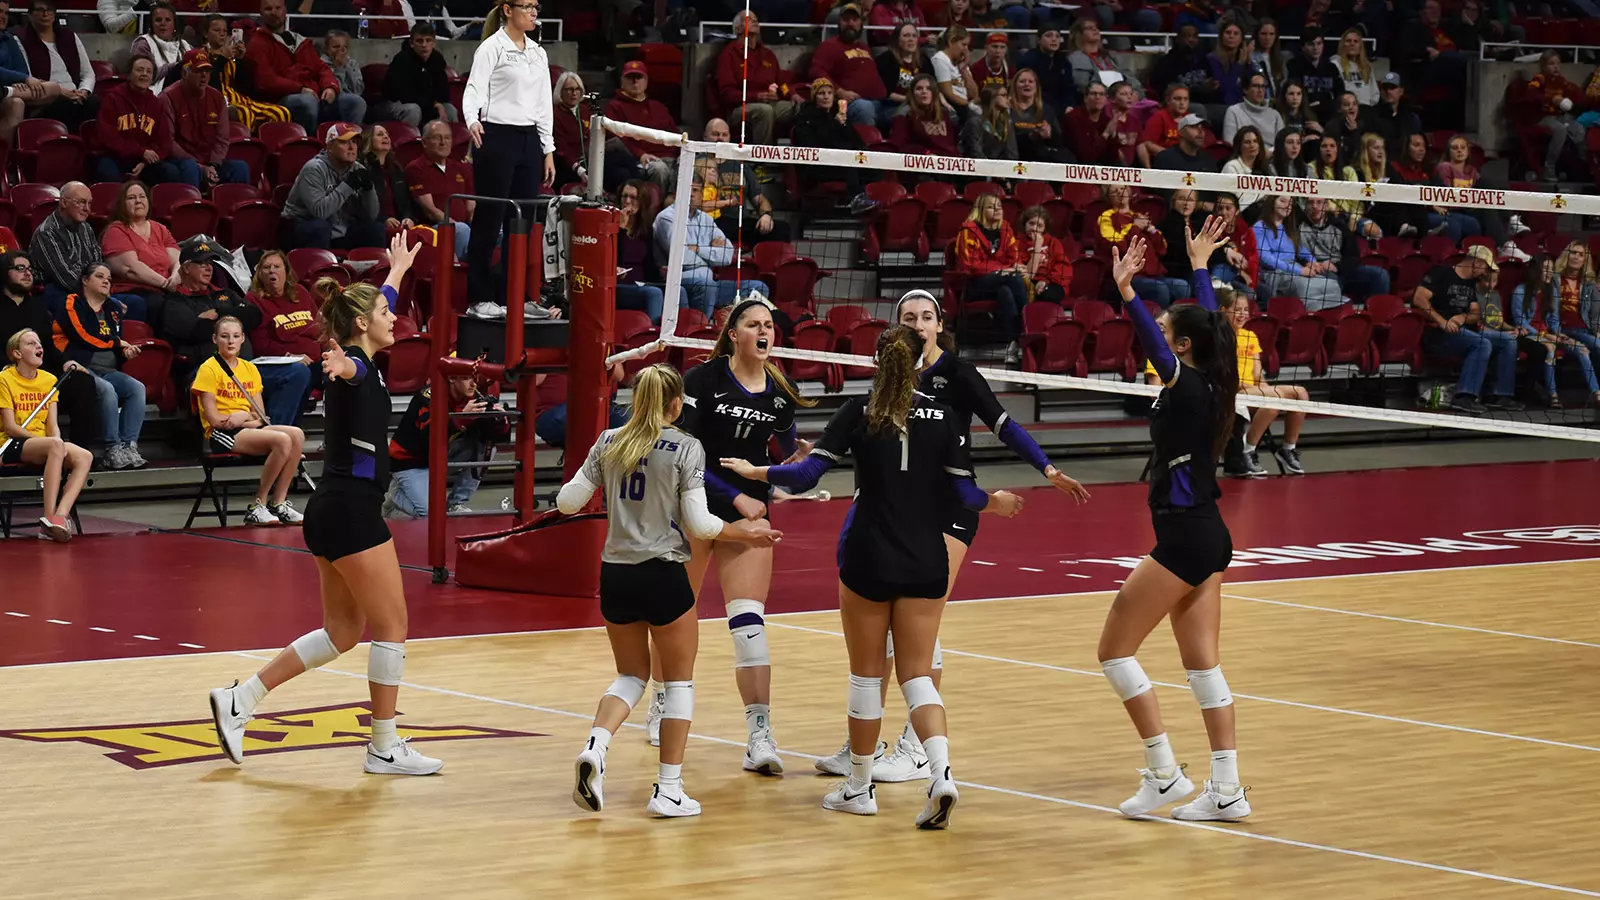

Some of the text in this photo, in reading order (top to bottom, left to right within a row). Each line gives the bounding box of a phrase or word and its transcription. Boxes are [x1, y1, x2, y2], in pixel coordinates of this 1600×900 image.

[751, 145, 820, 162] IOWA STATE
[903, 155, 976, 172] IOWA STATE
[1065, 165, 1142, 183] IOWA STATE
[1236, 175, 1319, 195] IOWA STATE
[1419, 187, 1506, 206] IOWA STATE
[714, 403, 777, 422] K-STATE
[734, 420, 755, 439] 11
[619, 471, 646, 502] 10
